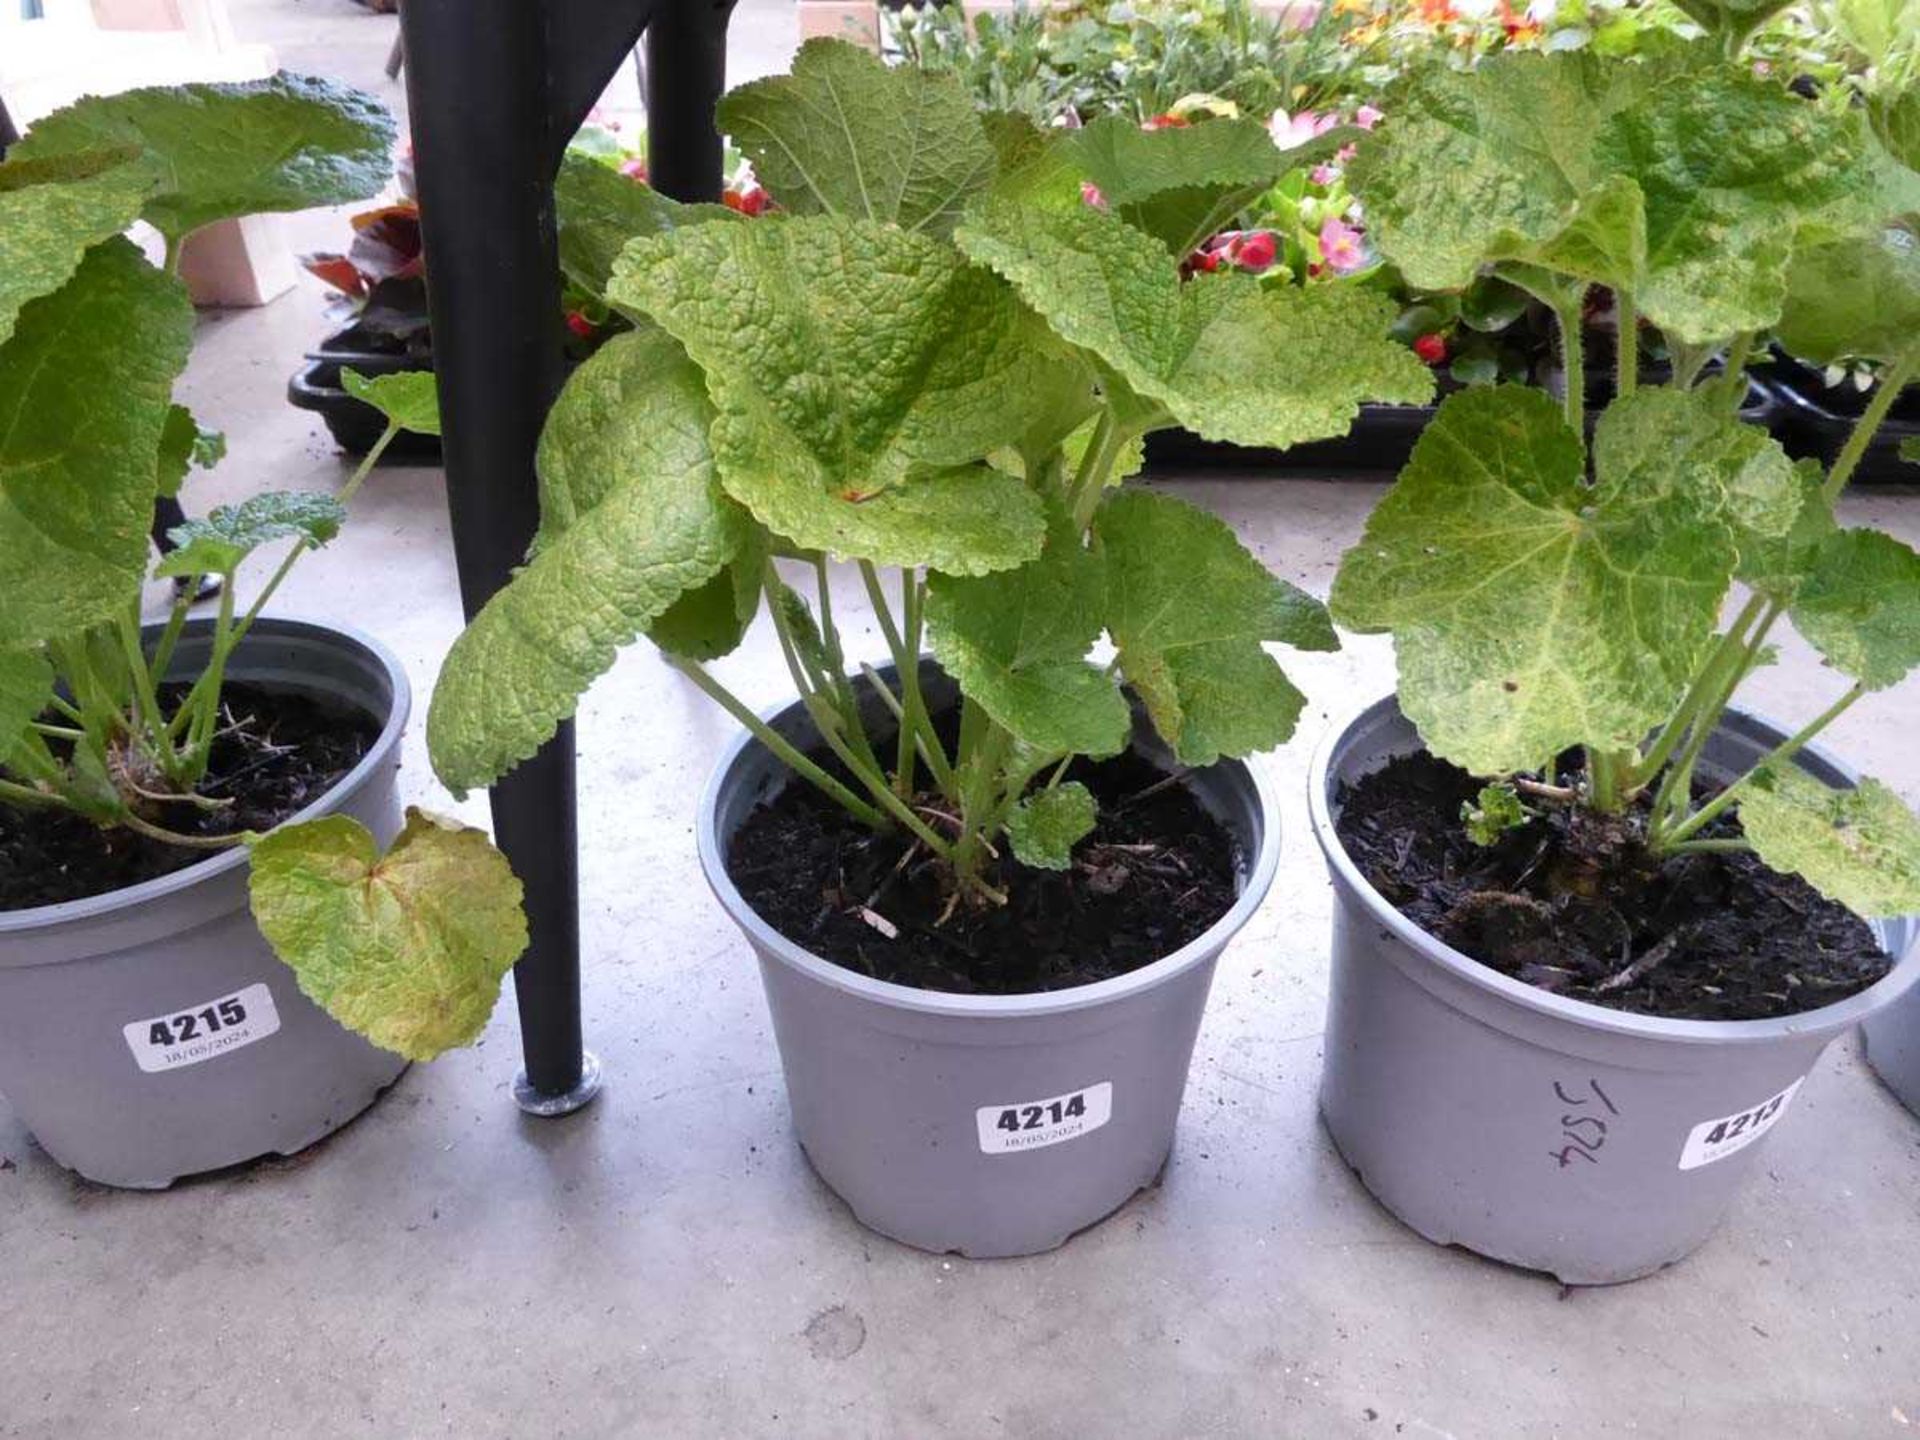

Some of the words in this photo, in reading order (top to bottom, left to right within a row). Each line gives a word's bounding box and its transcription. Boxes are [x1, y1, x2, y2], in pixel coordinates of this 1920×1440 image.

[149, 997, 246, 1046] 4215
[166, 1028, 250, 1063] 18/05/2024
[997, 1094, 1086, 1132] 4214
[1704, 1094, 1785, 1144] 4213
[1005, 1122, 1083, 1146] 18/05/2024
